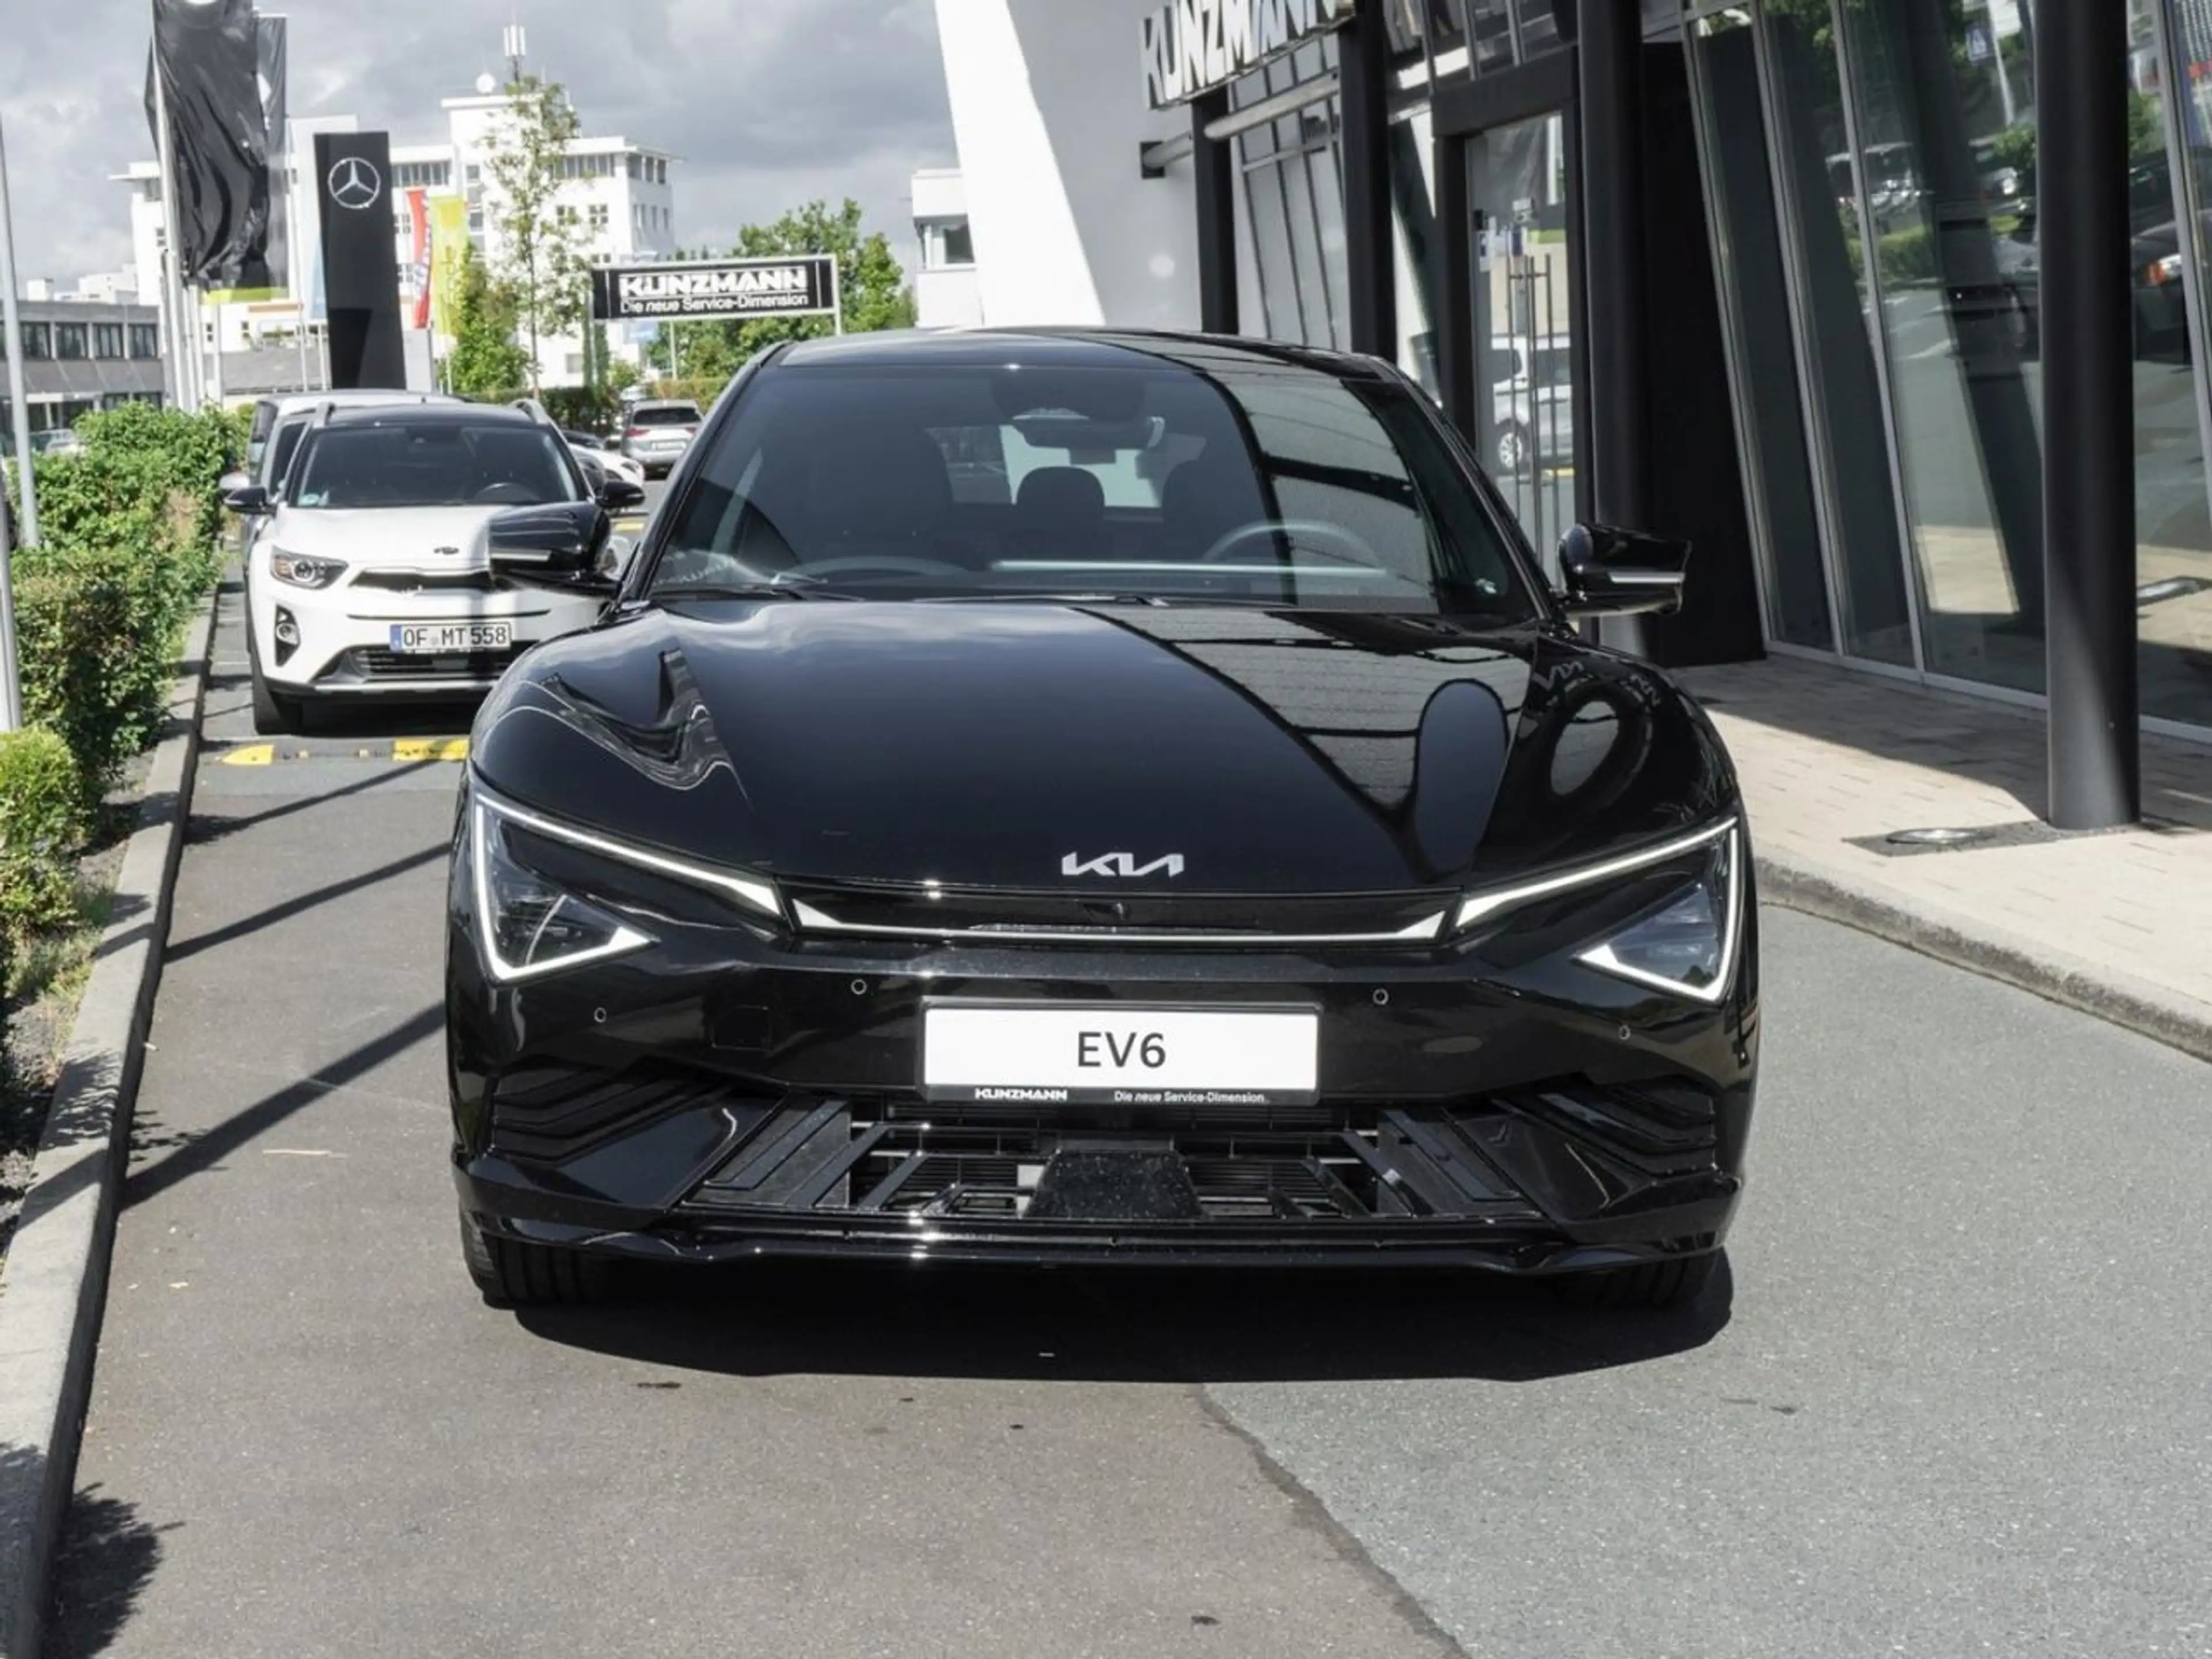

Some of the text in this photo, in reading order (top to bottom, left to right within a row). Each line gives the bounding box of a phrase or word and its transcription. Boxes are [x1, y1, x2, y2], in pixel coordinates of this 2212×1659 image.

[1140, 0, 1336, 109] KUNZM
[620, 267, 806, 297] KUNZMANN
[620, 294, 808, 313] Die neue Service-Dimension
[404, 626, 506, 646] OF MT 558
[1062, 851, 1184, 878] KIA
[1078, 1031, 1166, 1069] EV6
[975, 1088, 1265, 1104] KUNZMANN Die neue Service-Dimension
